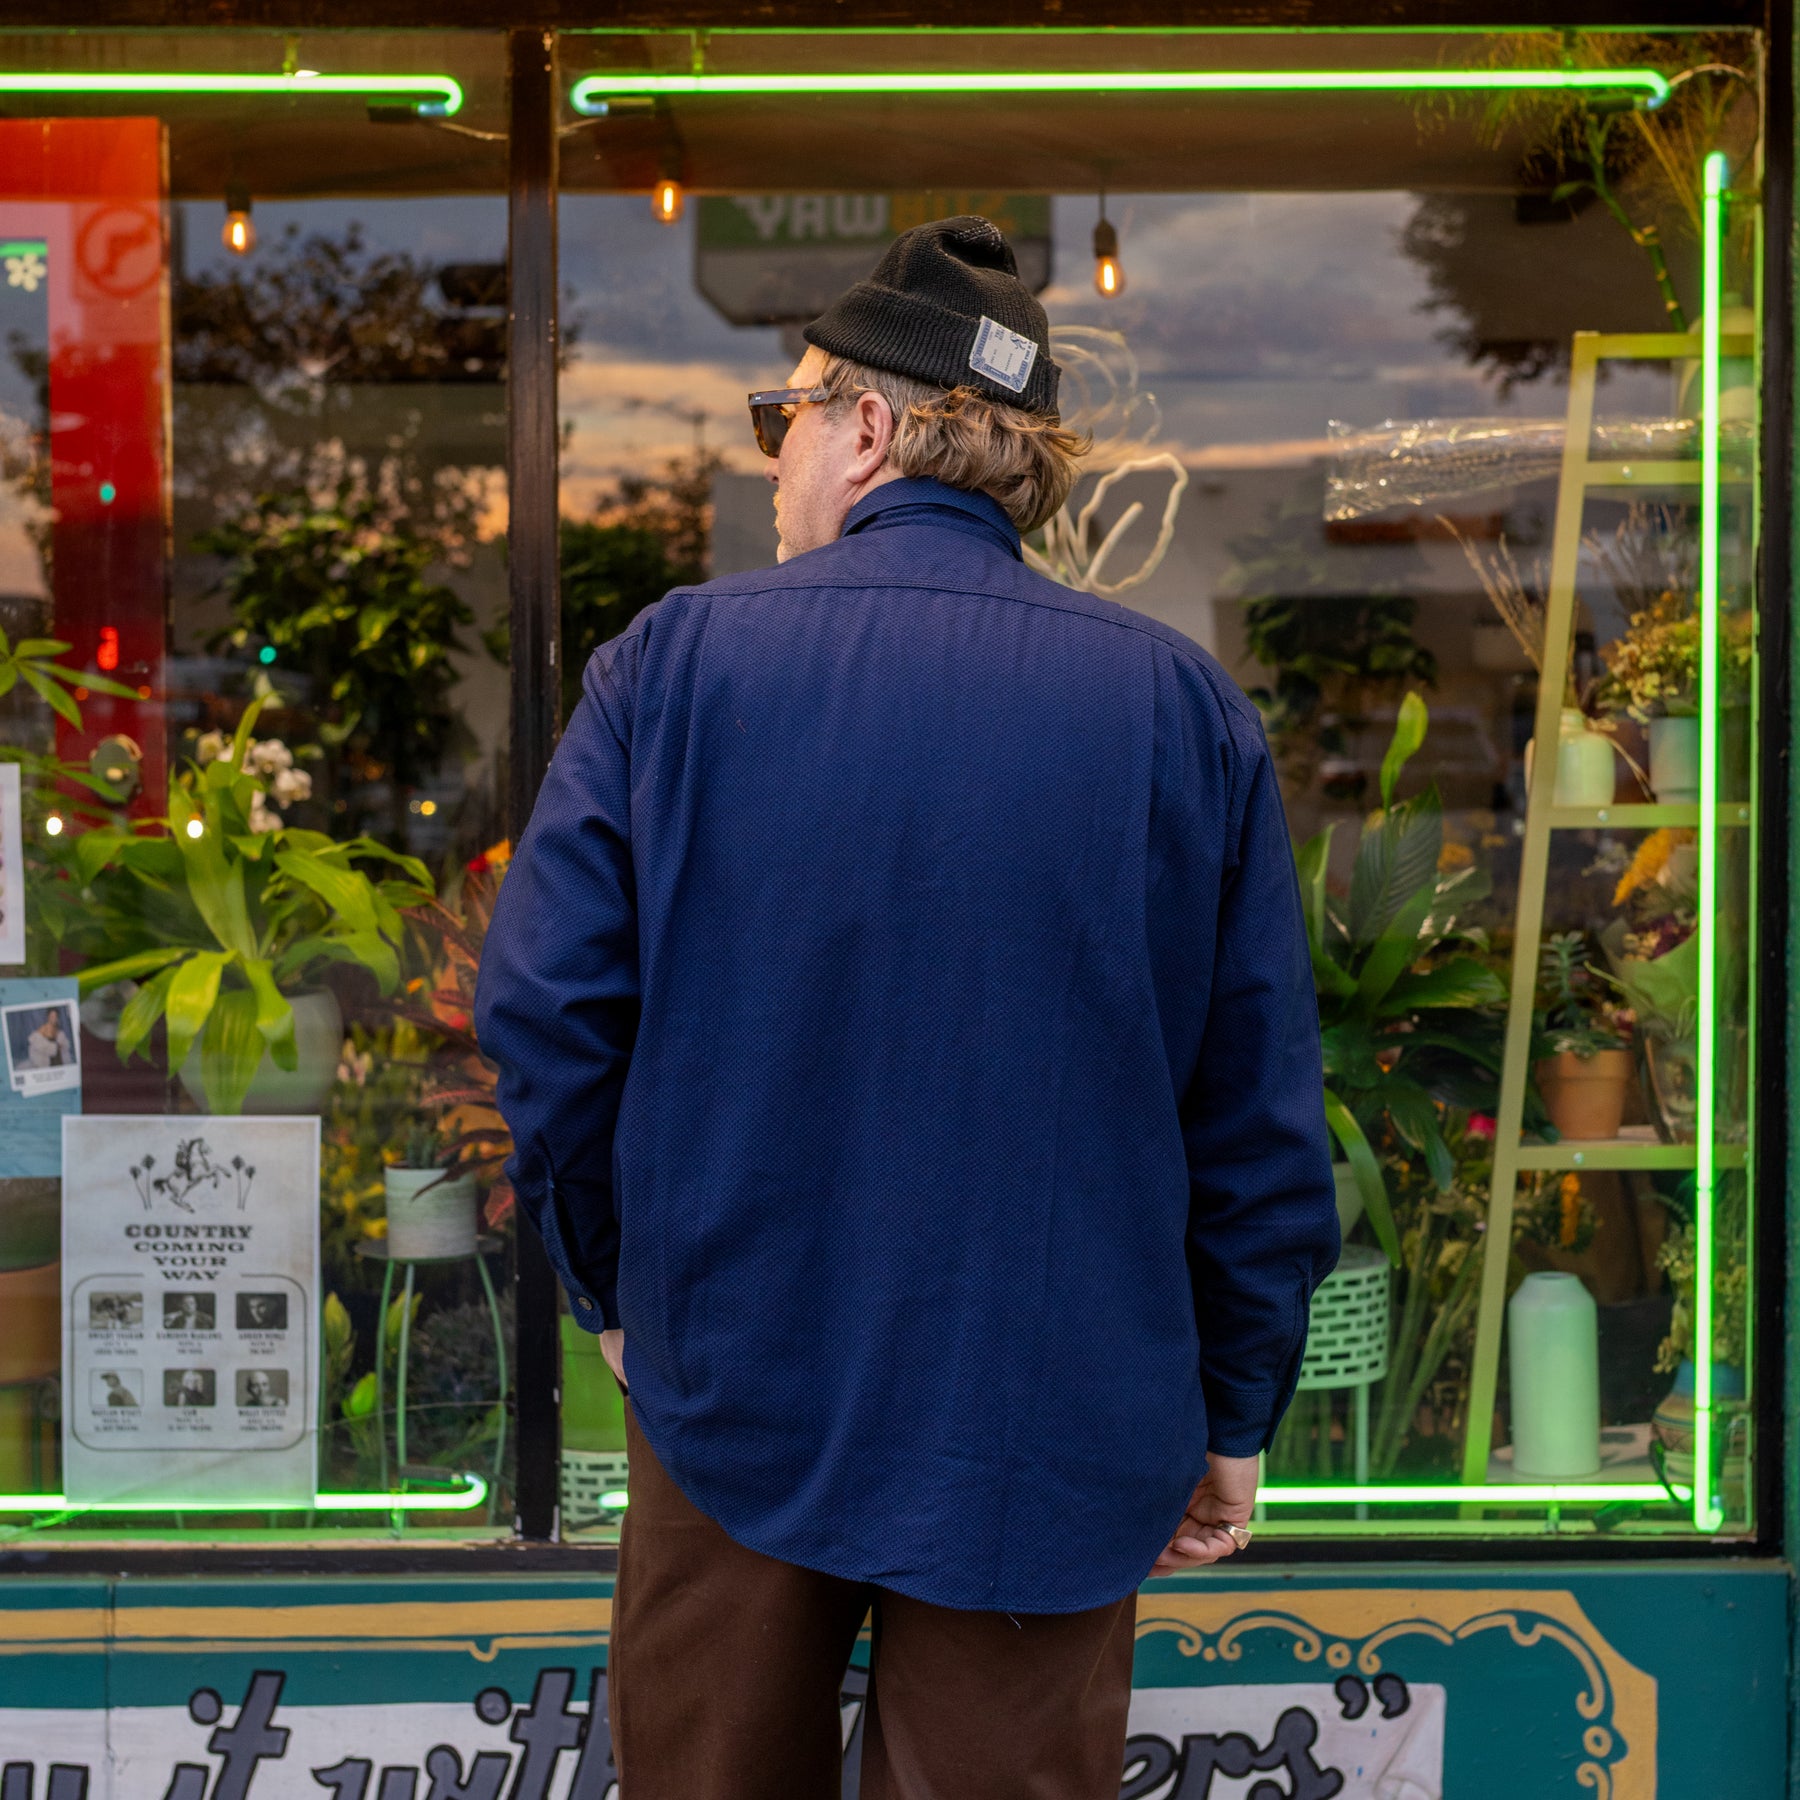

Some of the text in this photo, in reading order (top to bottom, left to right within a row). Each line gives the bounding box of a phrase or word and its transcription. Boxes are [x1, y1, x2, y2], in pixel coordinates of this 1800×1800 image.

[124, 1224, 253, 1239] COUNTRY
[134, 1241, 245, 1253] COMING
[153, 1255, 228, 1267] YOUR
[161, 1270, 219, 1281] WAY
